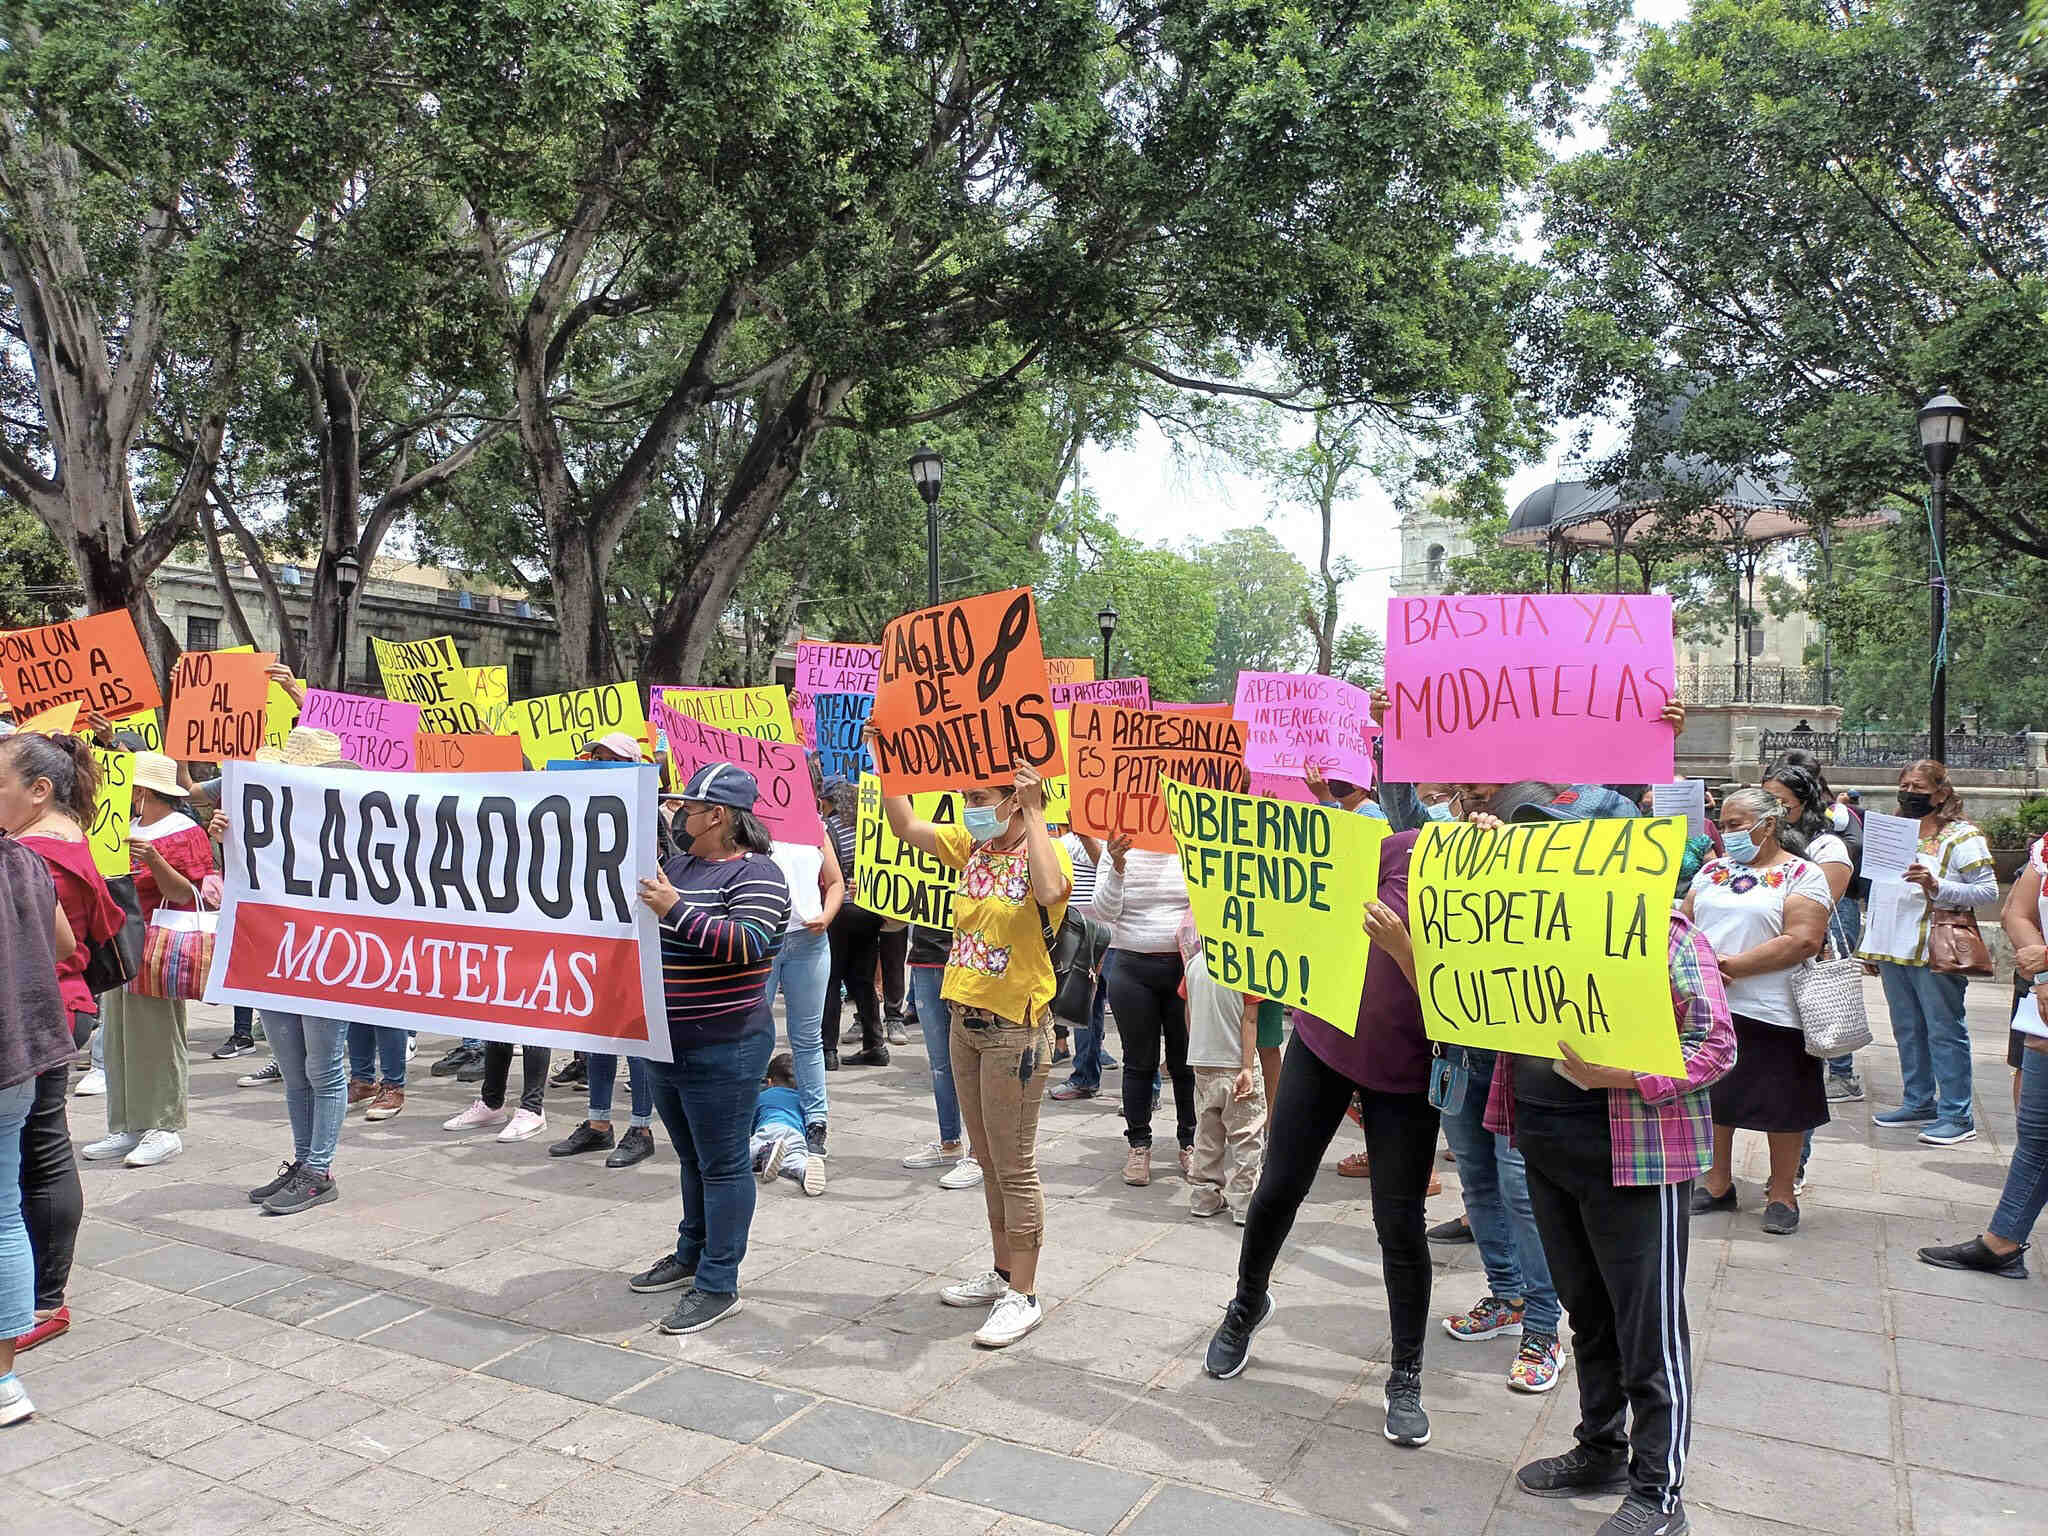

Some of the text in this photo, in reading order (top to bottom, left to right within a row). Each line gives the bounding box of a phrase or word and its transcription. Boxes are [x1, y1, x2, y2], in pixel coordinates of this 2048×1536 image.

[41, 623, 81, 657] UN
[881, 605, 976, 684] LAGIO
[1403, 595, 1644, 646] BASTA YA
[17, 647, 113, 696] ALTO A
[798, 644, 882, 671] DEFIENDO
[808, 667, 877, 693] EL ARTE
[209, 683, 234, 712] AL
[306, 694, 391, 734] PROTEGE
[527, 684, 624, 740] PLAGIO
[914, 671, 962, 716] DE
[1052, 686, 1071, 704] LA
[1396, 663, 1671, 741] MODATELAS
[186, 709, 264, 758] PLAGIO!
[876, 693, 1057, 781] MODATELAS
[1070, 703, 1242, 751] LA ARTESANIA
[1078, 746, 1106, 779] ES
[1112, 755, 1243, 794] PATRIMONIO
[1166, 782, 1332, 858] GOBIERNO
[242, 783, 633, 924] PLAGIADOR
[1419, 817, 1673, 881] MODATELAS
[857, 864, 954, 931] MODATE
[1222, 896, 1265, 938] AL
[1418, 885, 1648, 960] RESPETA LA
[266, 920, 598, 1018] MODATELAS
[1429, 962, 1611, 1035] CULTURA
